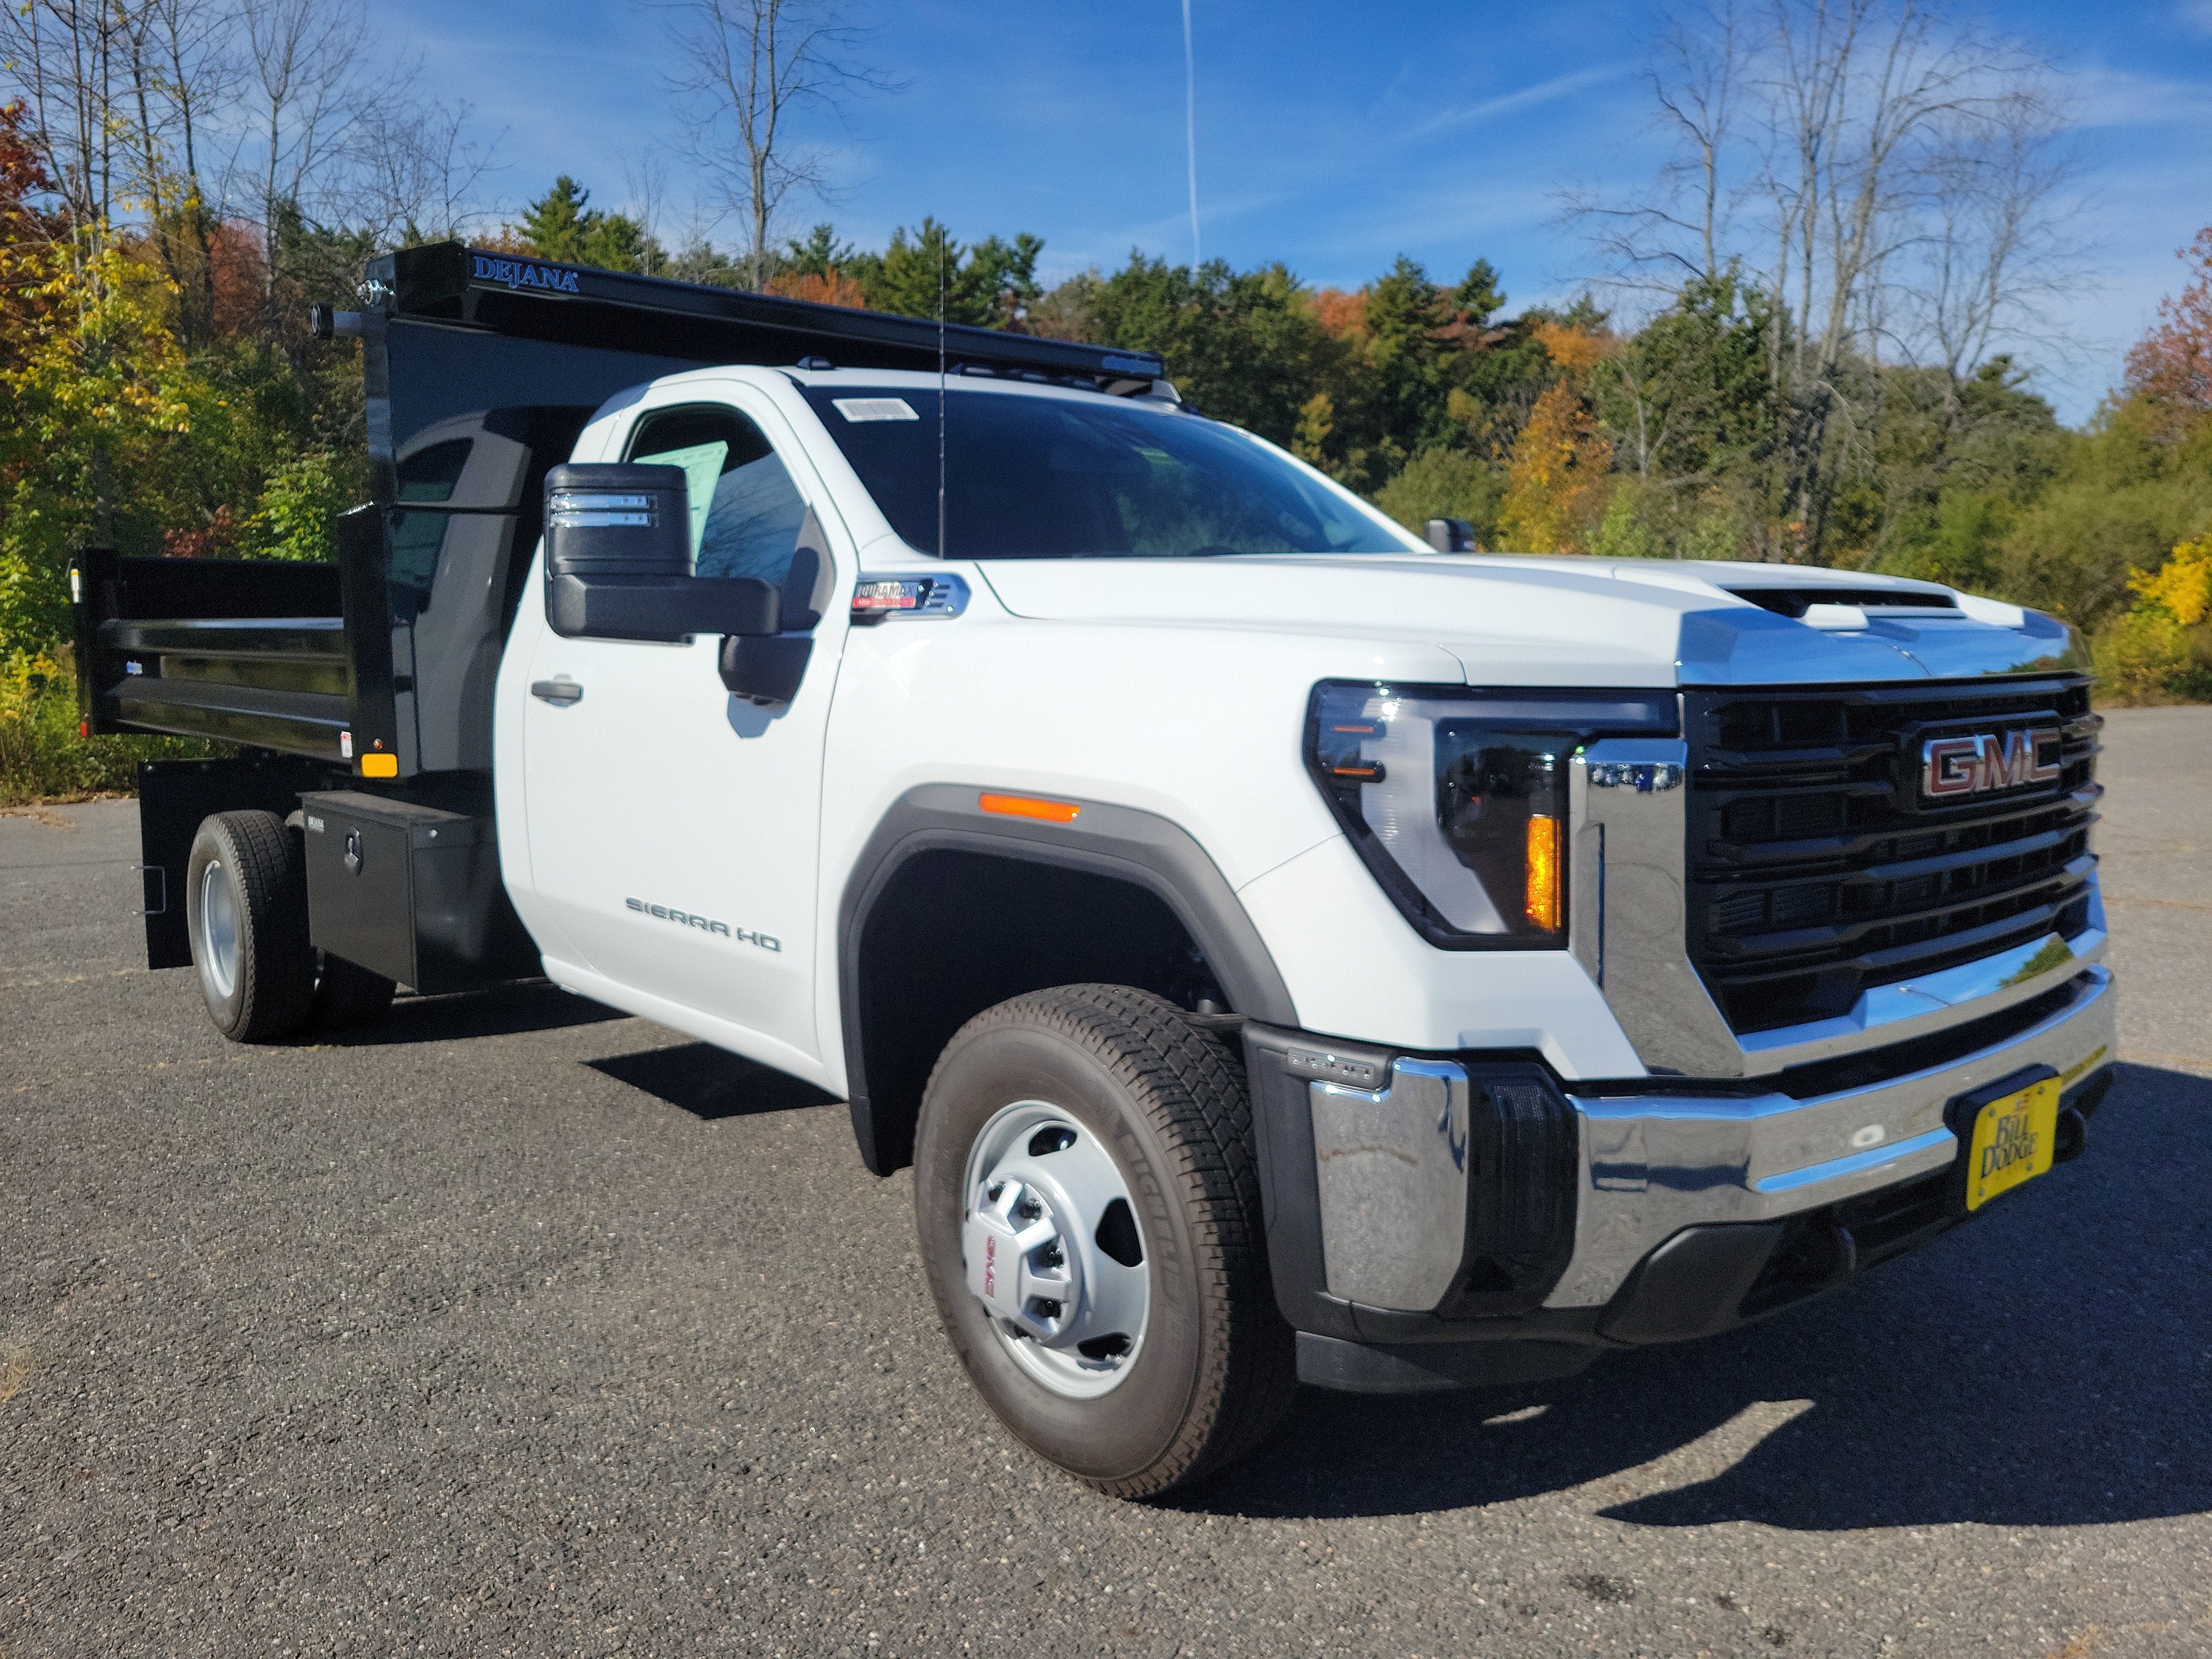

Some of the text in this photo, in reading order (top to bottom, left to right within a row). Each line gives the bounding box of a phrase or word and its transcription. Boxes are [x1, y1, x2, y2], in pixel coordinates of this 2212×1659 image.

[474, 256, 579, 292] DEJANA
[1923, 728, 2061, 797] GMC
[625, 896, 783, 952] SIERRA HD
